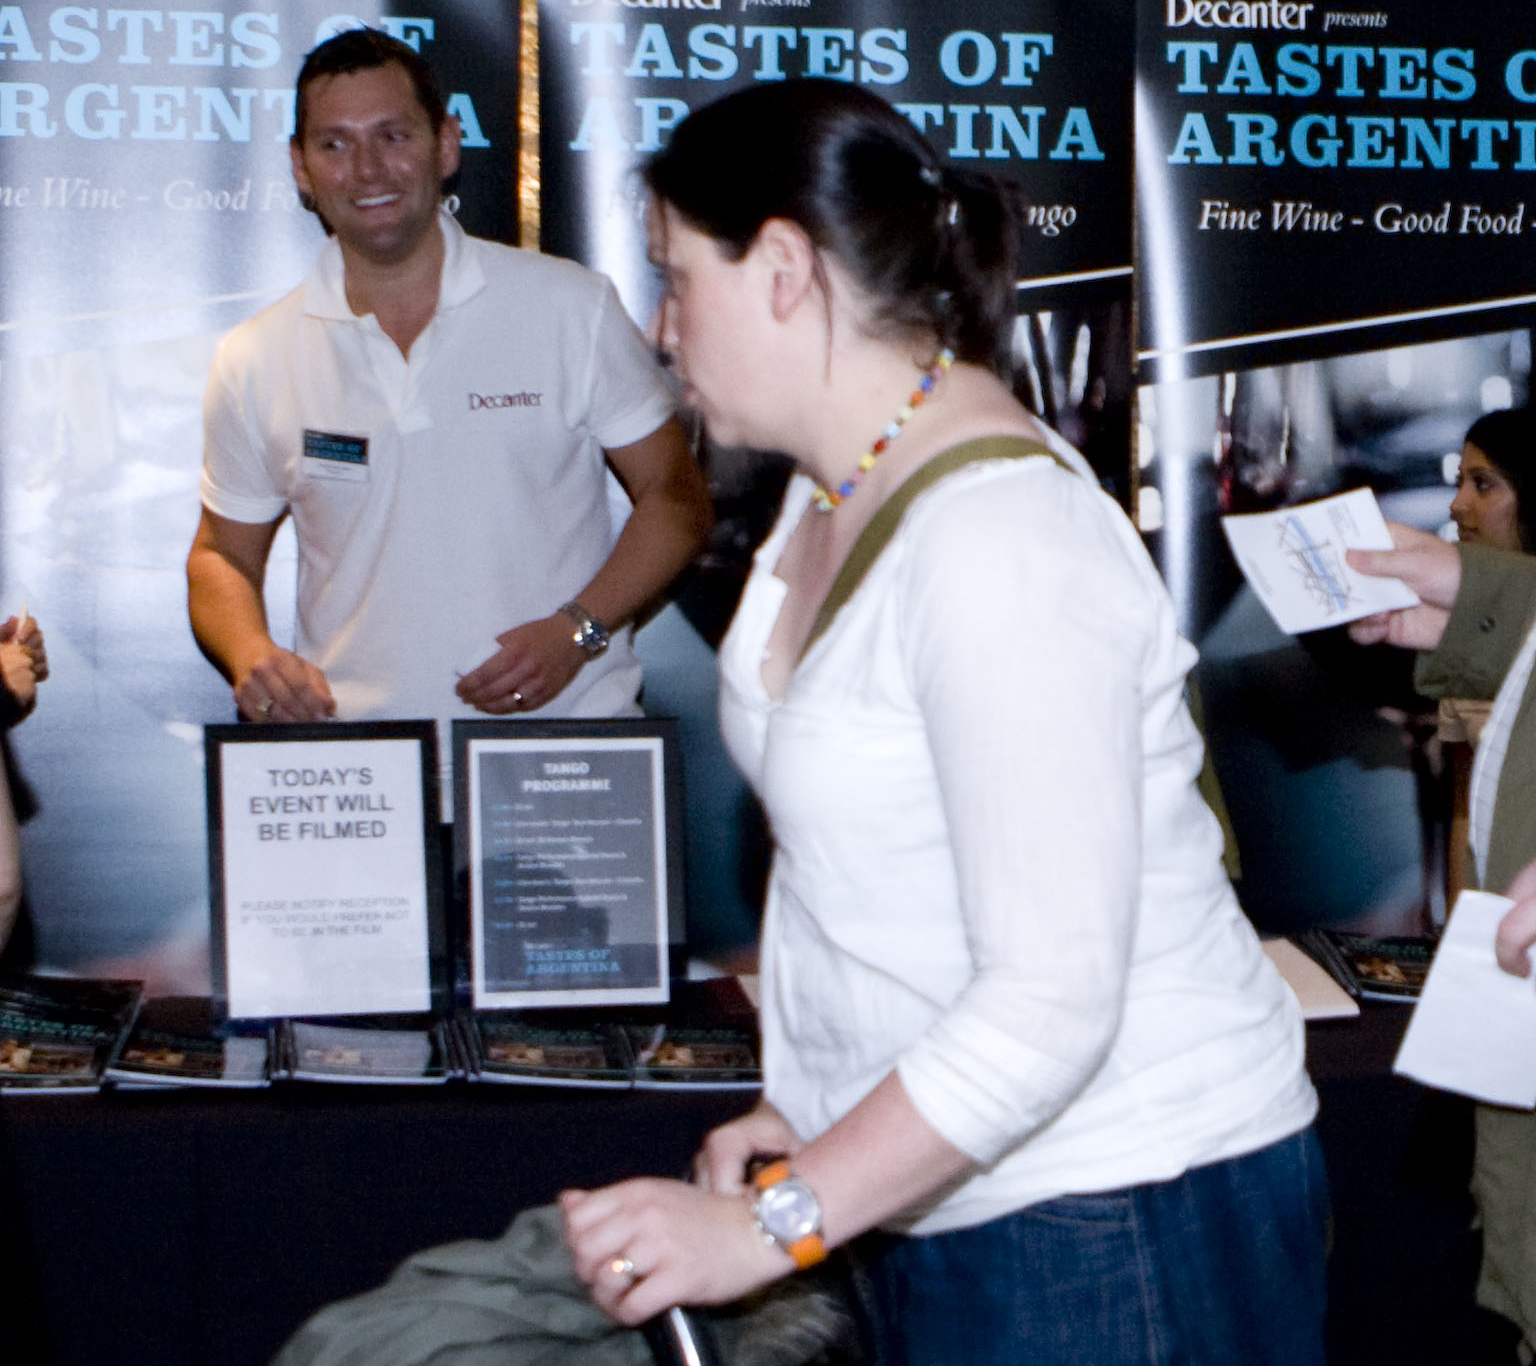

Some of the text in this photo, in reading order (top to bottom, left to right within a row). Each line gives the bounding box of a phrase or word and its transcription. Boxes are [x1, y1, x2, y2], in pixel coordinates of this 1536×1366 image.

[1324, 9, 1388, 32] presents
[570, 22, 1054, 87] TASTES OF
[1167, 41, 1477, 102] TASTES
[569, 97, 1106, 161] ARTINA
[42, 178, 128, 210] Wine
[164, 179, 250, 212] Good
[1198, 200, 1261, 232] Fine
[1271, 201, 1344, 233] Wine
[1374, 203, 1450, 235] Good
[1459, 205, 1523, 235] Food
[468, 391, 543, 411] Decanter
[267, 767, 373, 787] TODAY'S
[543, 762, 591, 776] TANGO
[521, 778, 612, 792] PROGRAMME
[249, 793, 394, 814] EVENT WILL
[258, 820, 387, 841] BE FILMED
[524, 961, 621, 976] ARGENTINA
